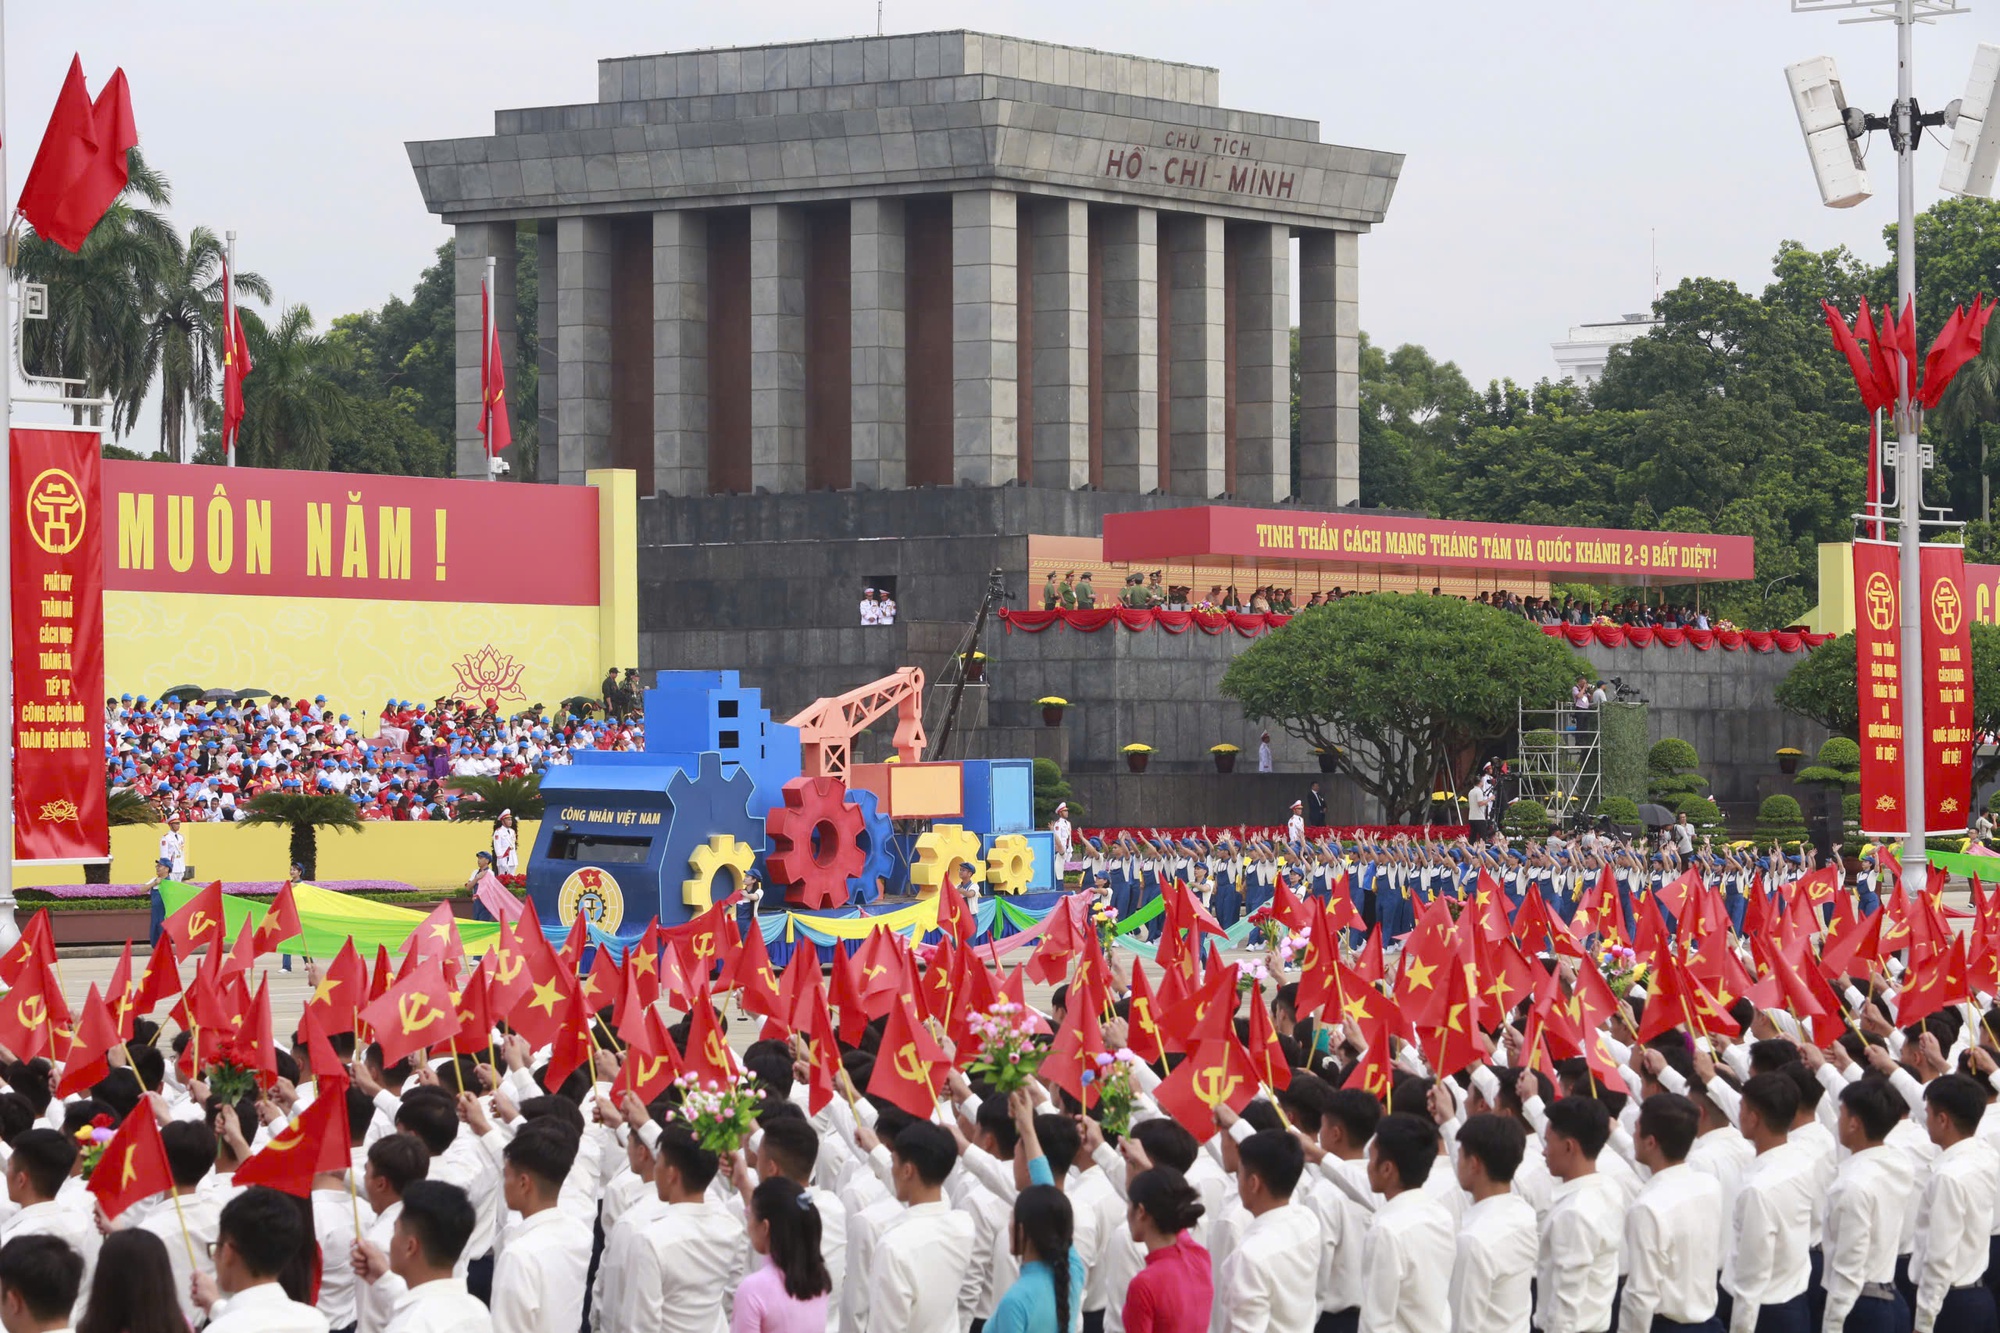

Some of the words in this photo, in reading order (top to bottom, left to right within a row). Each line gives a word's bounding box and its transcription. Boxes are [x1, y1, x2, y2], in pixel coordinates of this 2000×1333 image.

[1165, 127, 1200, 149] CHỦ
[1105, 145, 1146, 179] HỒ
[1164, 155, 1211, 188] CHÍ
[1228, 161, 1295, 199] MINH
[118, 483, 271, 575] MUÔN
[307, 490, 411, 580] NĂM
[435, 508, 447, 581] !
[1256, 523, 1294, 549] TINH
[1298, 520, 1339, 551] THẦN
[1343, 525, 1381, 554] CÁCH
[1385, 531, 1427, 559] MẠNG
[1430, 530, 1478, 559] THÁNG
[1481, 532, 1512, 560] TÁM
[1515, 534, 1534, 561] VÀ
[1537, 534, 1571, 564] QUỐC
[1575, 538, 1621, 566] KHÁNH
[1624, 544, 1649, 566] 2-9
[1652, 539, 1678, 568] BẤT
[44, 570, 60, 591] PHÁT
[40, 622, 59, 643] CÁCH
[39, 649, 61, 669] THÁNG
[46, 675, 60, 696] TIẾP
[22, 701, 45, 722] CÔNG
[47, 701, 64, 726] CUỘC
[20, 727, 41, 748] TOÀN
[43, 727, 58, 752] DIỆN
[560, 806, 586, 822] CÔNG
[588, 808, 614, 824] NHÂN
[616, 809, 637, 827] VIỆT
[639, 812, 661, 825] NAM
